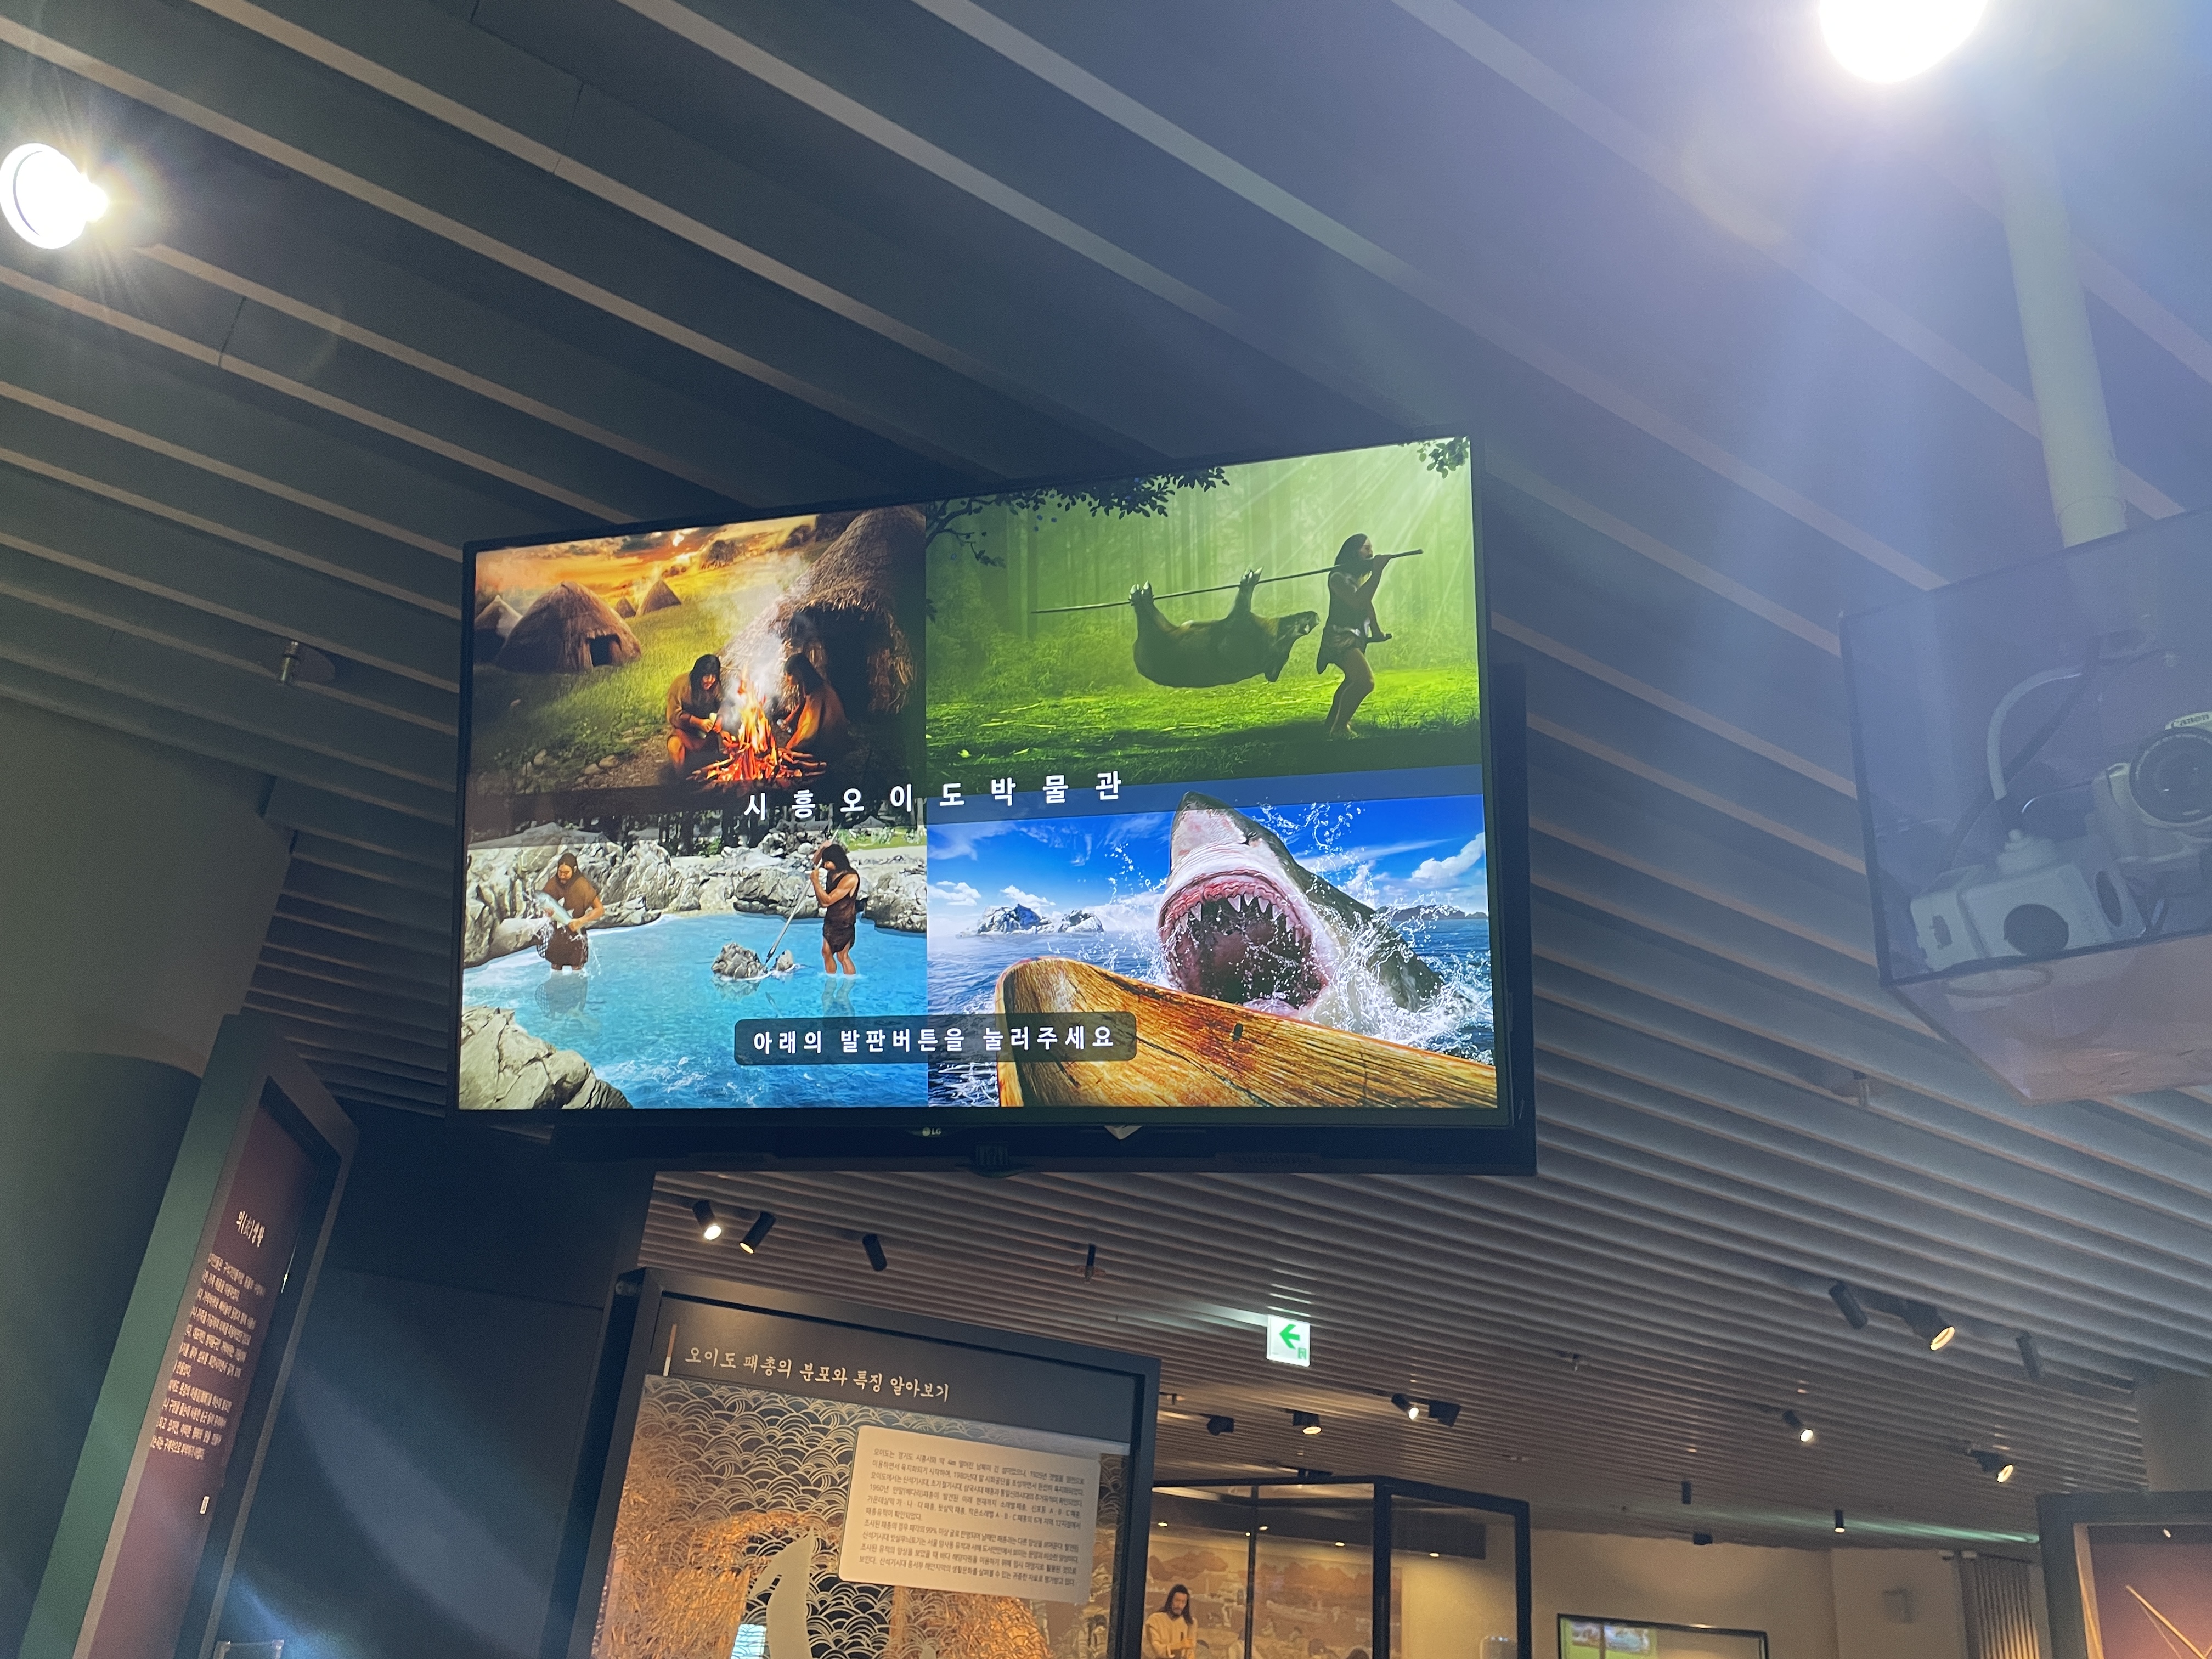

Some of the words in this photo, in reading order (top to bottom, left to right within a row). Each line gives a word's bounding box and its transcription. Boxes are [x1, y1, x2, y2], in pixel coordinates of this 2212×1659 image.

[753, 1030, 822, 1054] 아래의
[840, 1027, 966, 1053] 발판버튼을
[983, 1025, 1114, 1051] 눌러주세요
[685, 1347, 736, 1369] 오이도
[743, 1354, 792, 1379] 패총의
[799, 1362, 848, 1387] 분포와
[853, 1370, 883, 1393] 특징
[890, 1376, 950, 1403] 알아보기
[870, 1483, 889, 1493] 1960년
